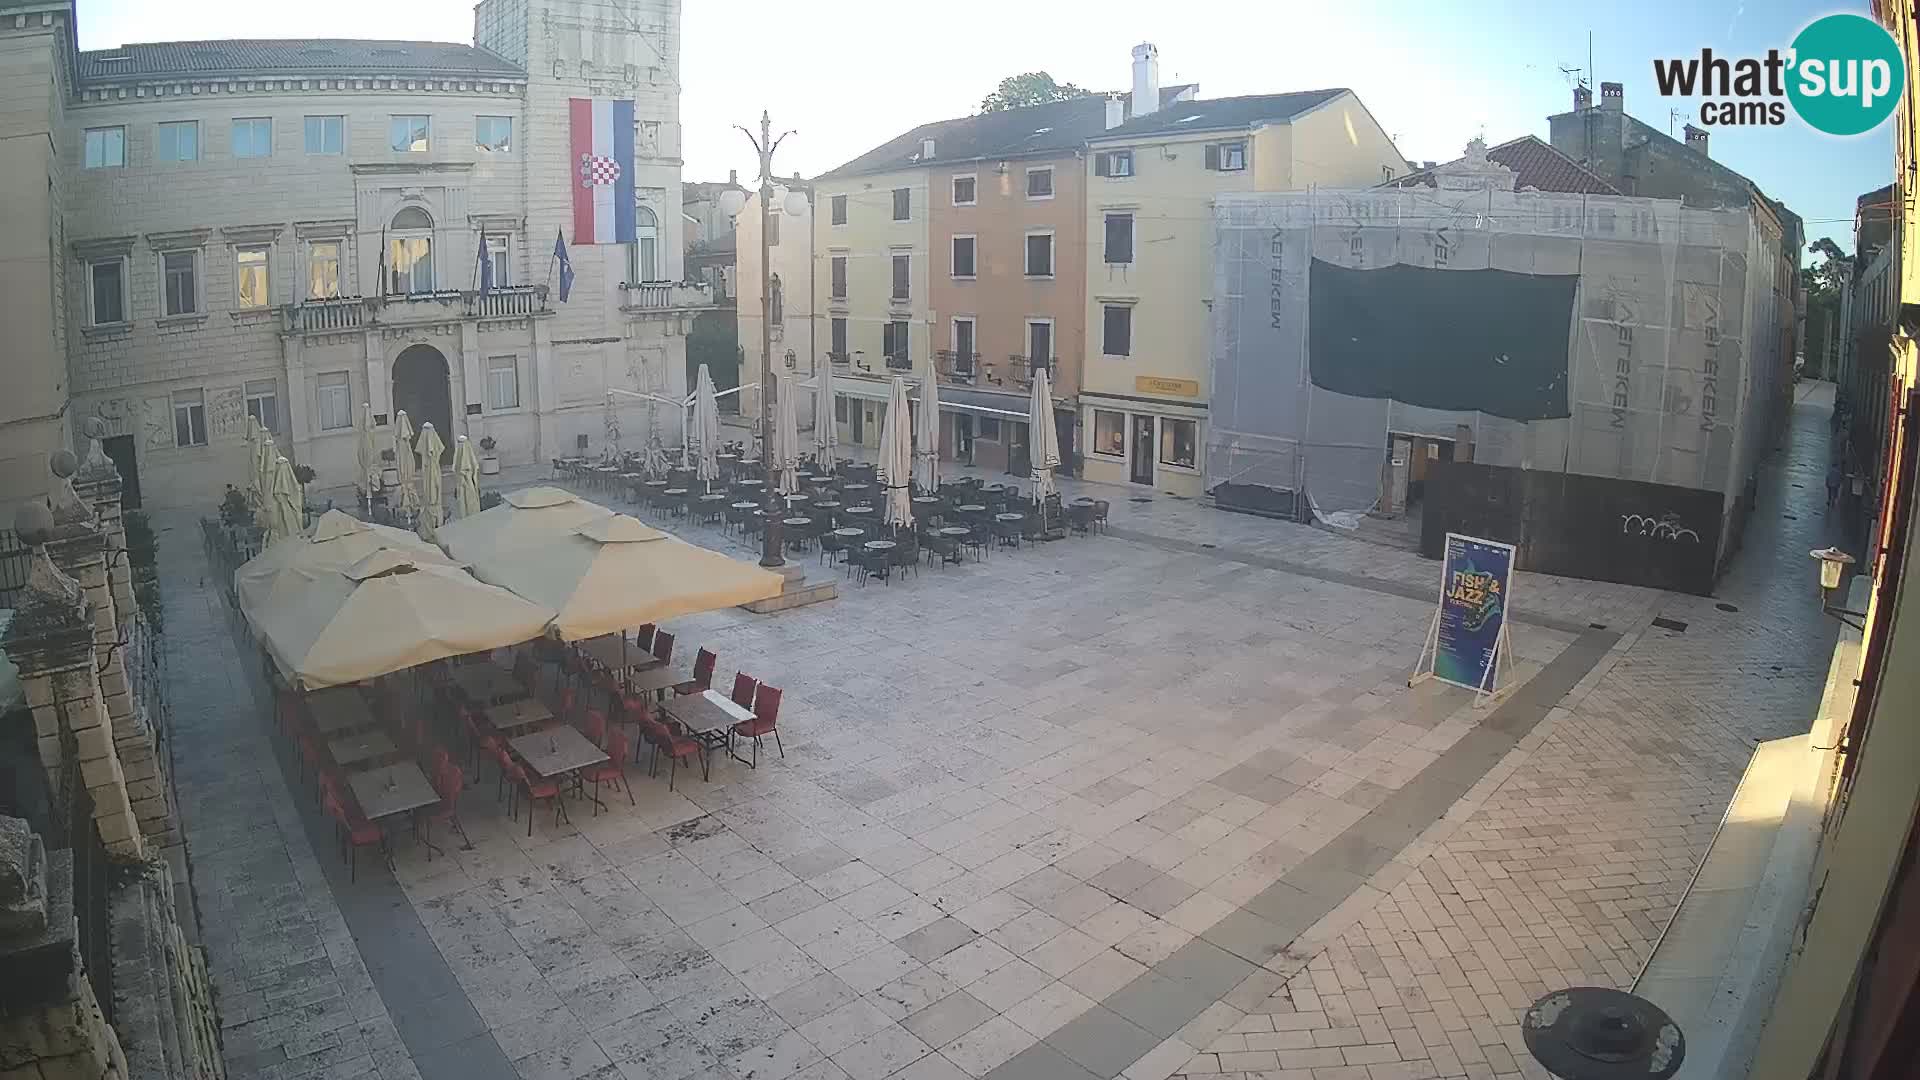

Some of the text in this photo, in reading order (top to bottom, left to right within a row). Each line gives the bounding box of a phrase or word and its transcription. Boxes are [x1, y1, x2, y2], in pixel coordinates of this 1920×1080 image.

[1453, 571, 1500, 594] FISH &
[1446, 584, 1484, 605] JAZZ
